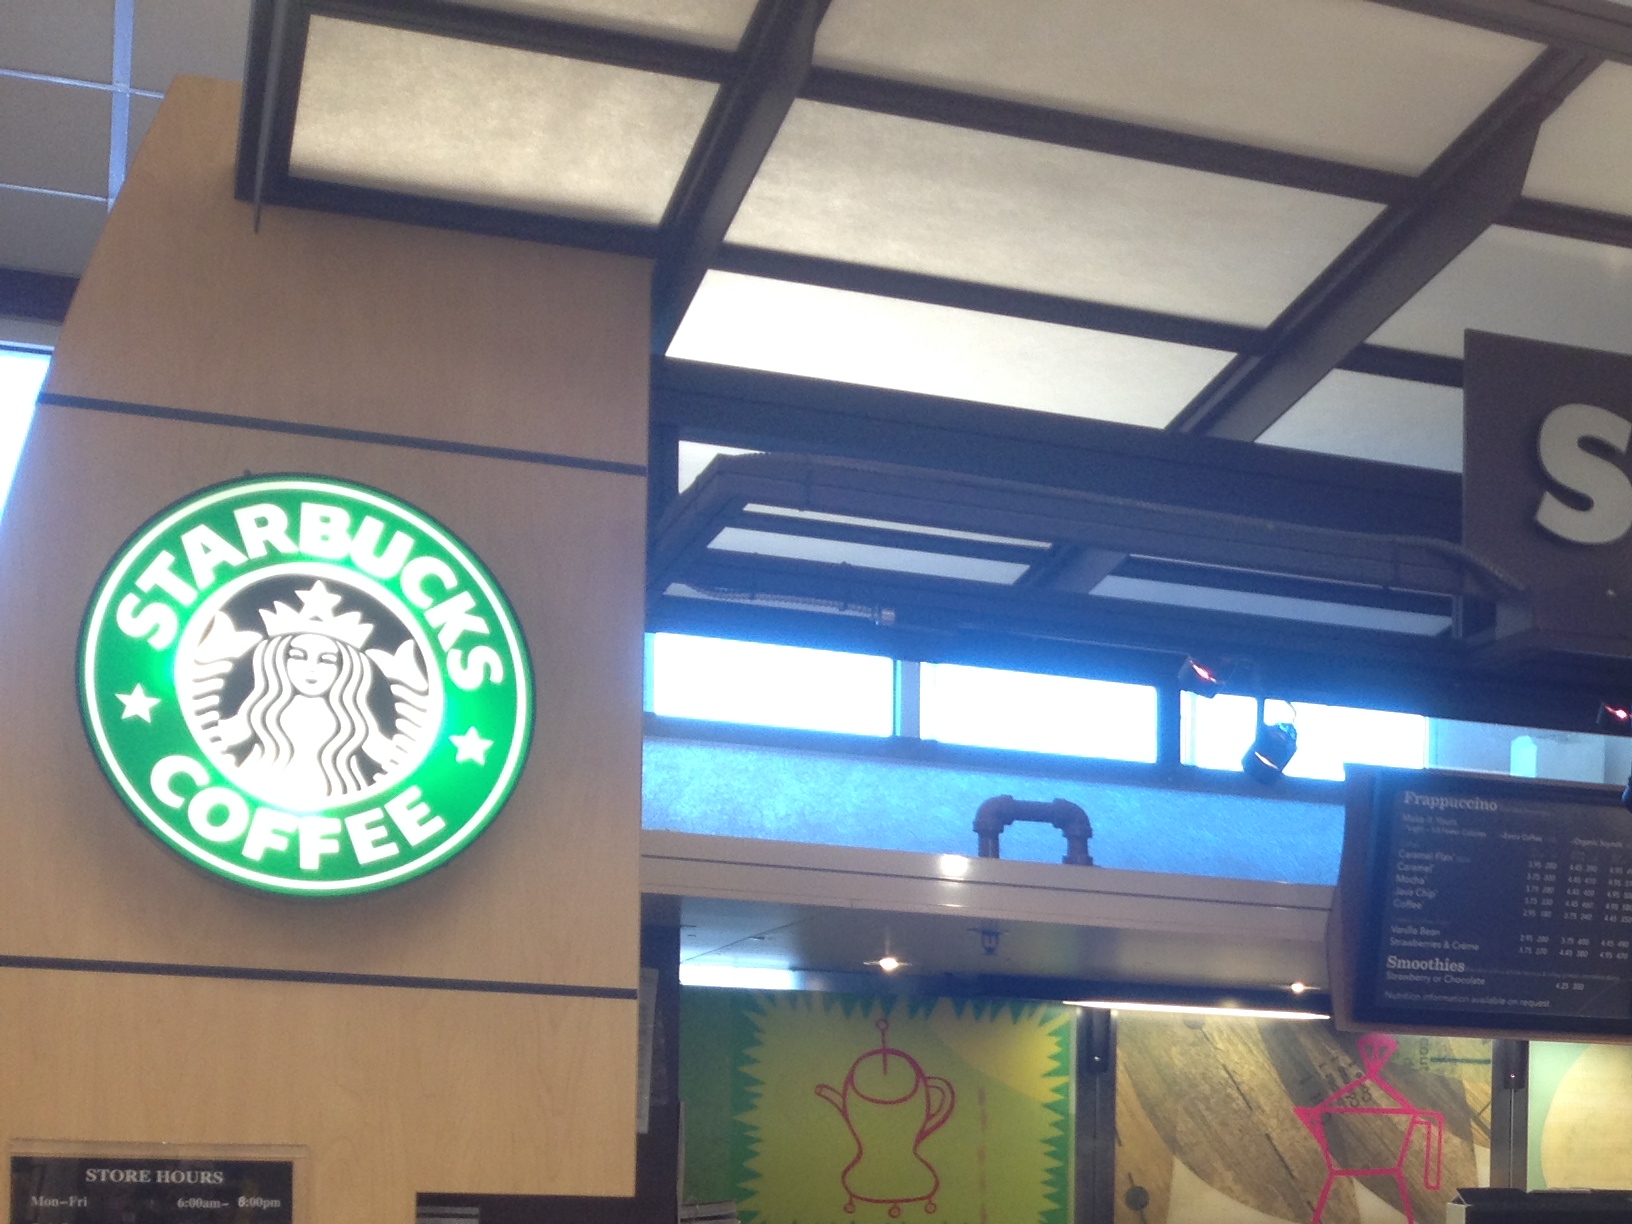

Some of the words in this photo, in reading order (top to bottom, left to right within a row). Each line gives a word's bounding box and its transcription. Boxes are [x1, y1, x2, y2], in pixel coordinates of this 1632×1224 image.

[116, 502, 504, 692] STARBUCKS
[1403, 790, 1498, 812] Frappuccino
[150, 754, 446, 871] COFFEE
[1386, 955, 1466, 973] Smoothies
[85, 1168, 151, 1184] STORE
[155, 1169, 224, 1185] HOURS
